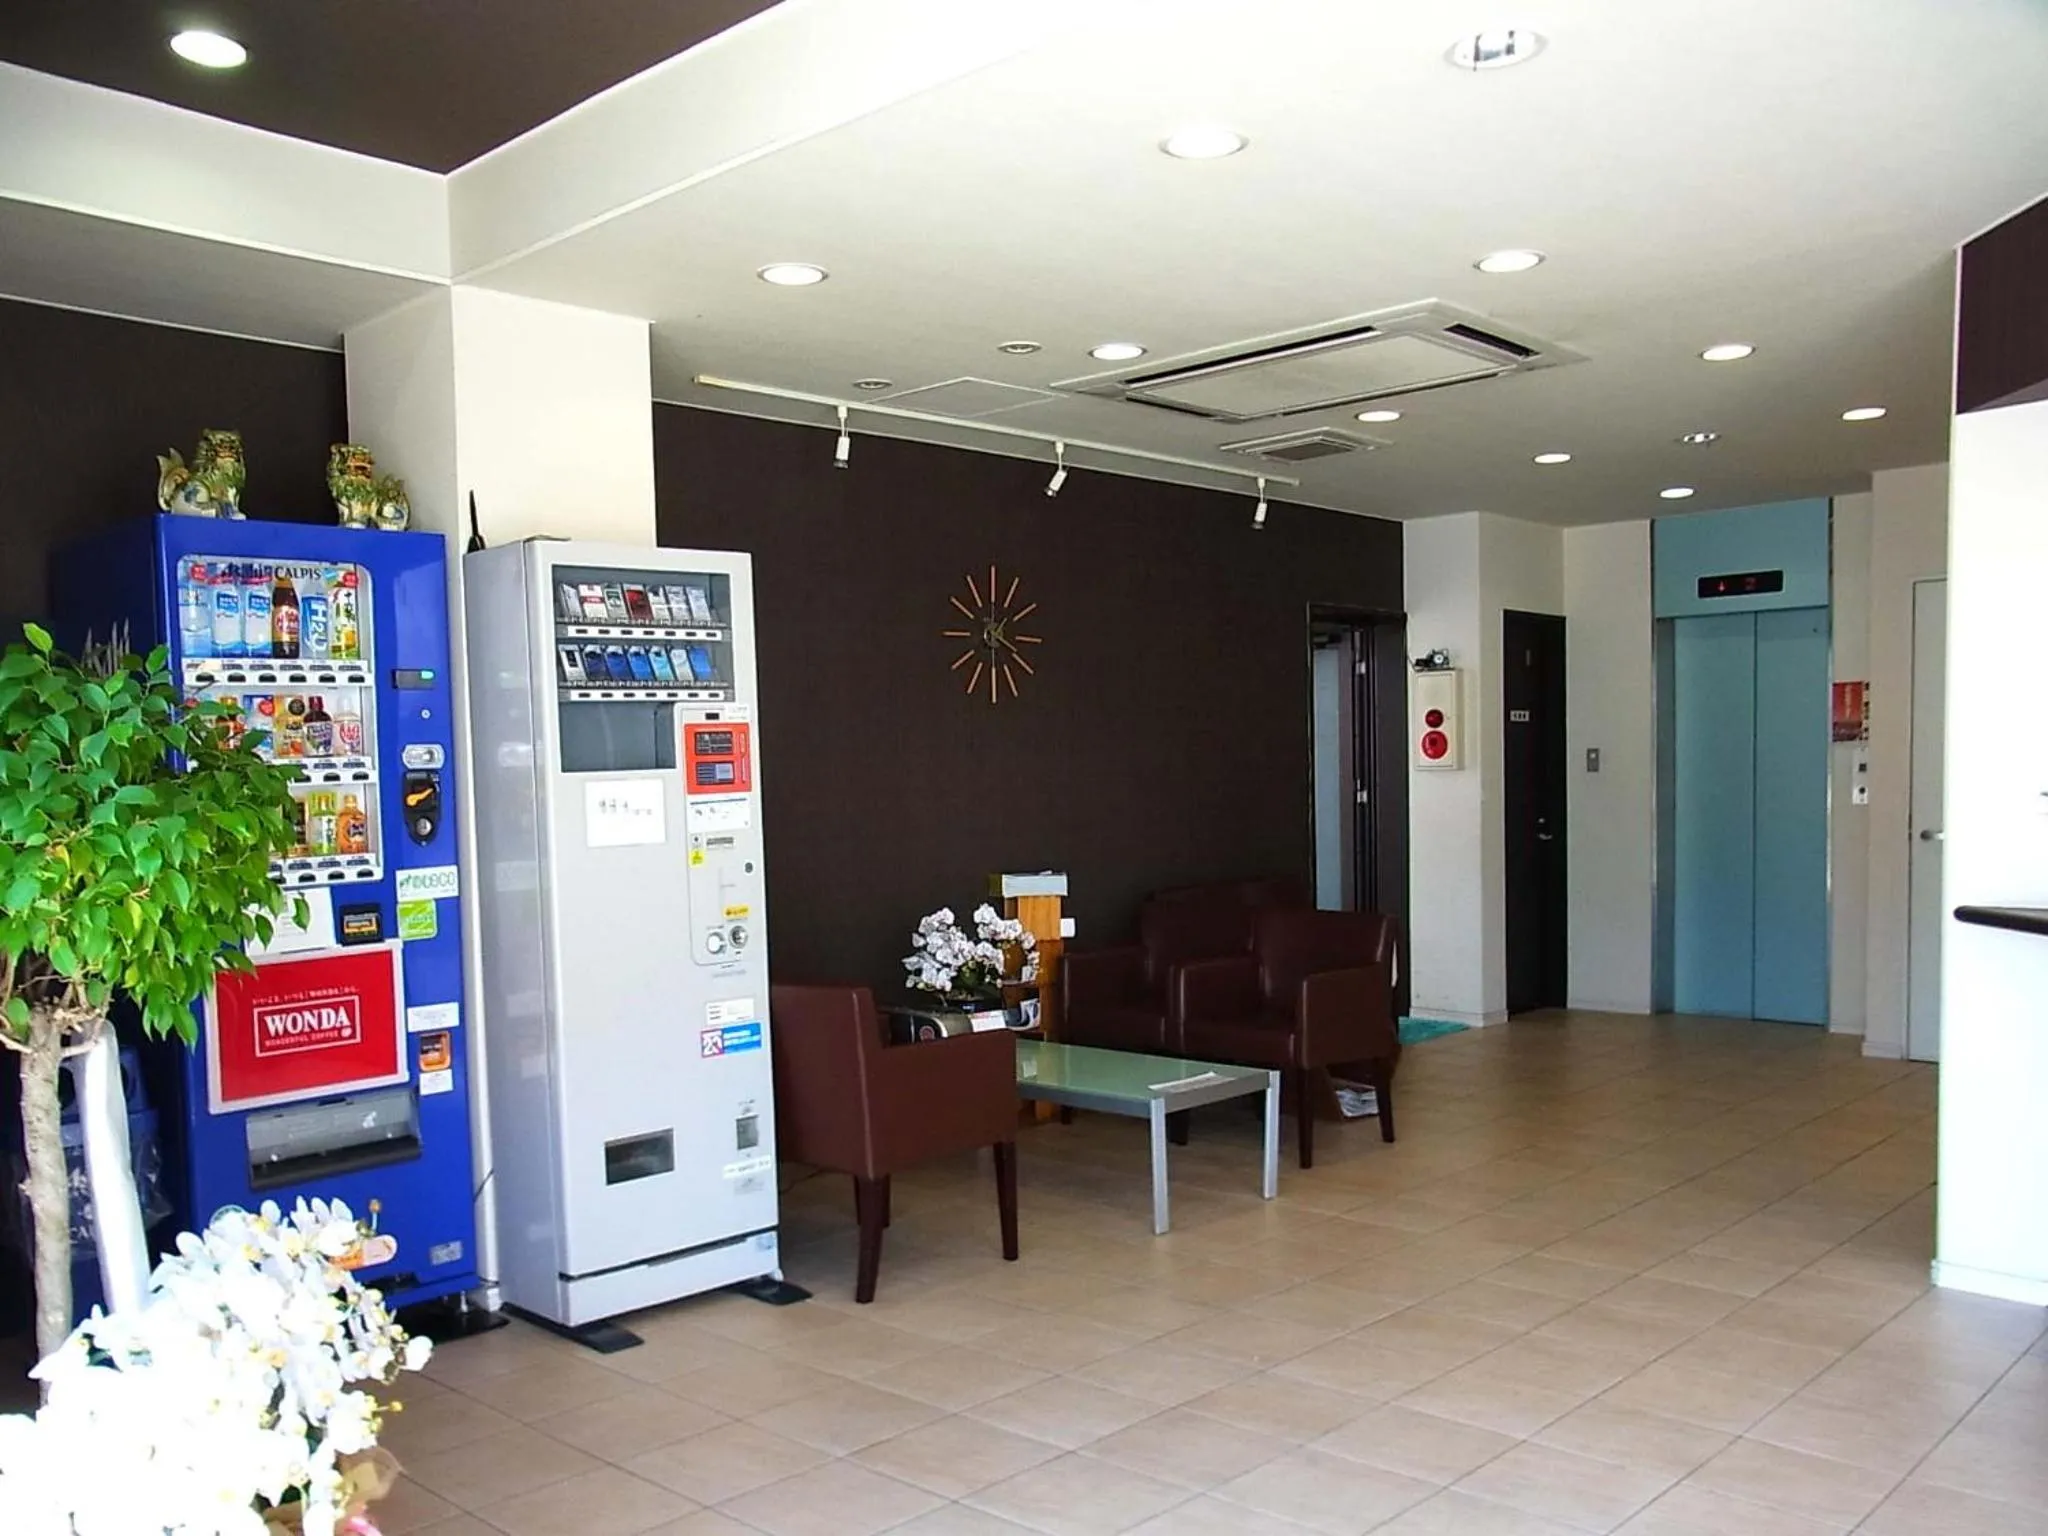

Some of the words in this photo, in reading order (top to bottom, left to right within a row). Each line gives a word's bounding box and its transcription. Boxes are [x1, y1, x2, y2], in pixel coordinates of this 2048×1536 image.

[275, 565, 322, 580] CALPIS
[264, 1005, 352, 1038] WONDA
[264, 1034, 310, 1047] WONDERFUL
